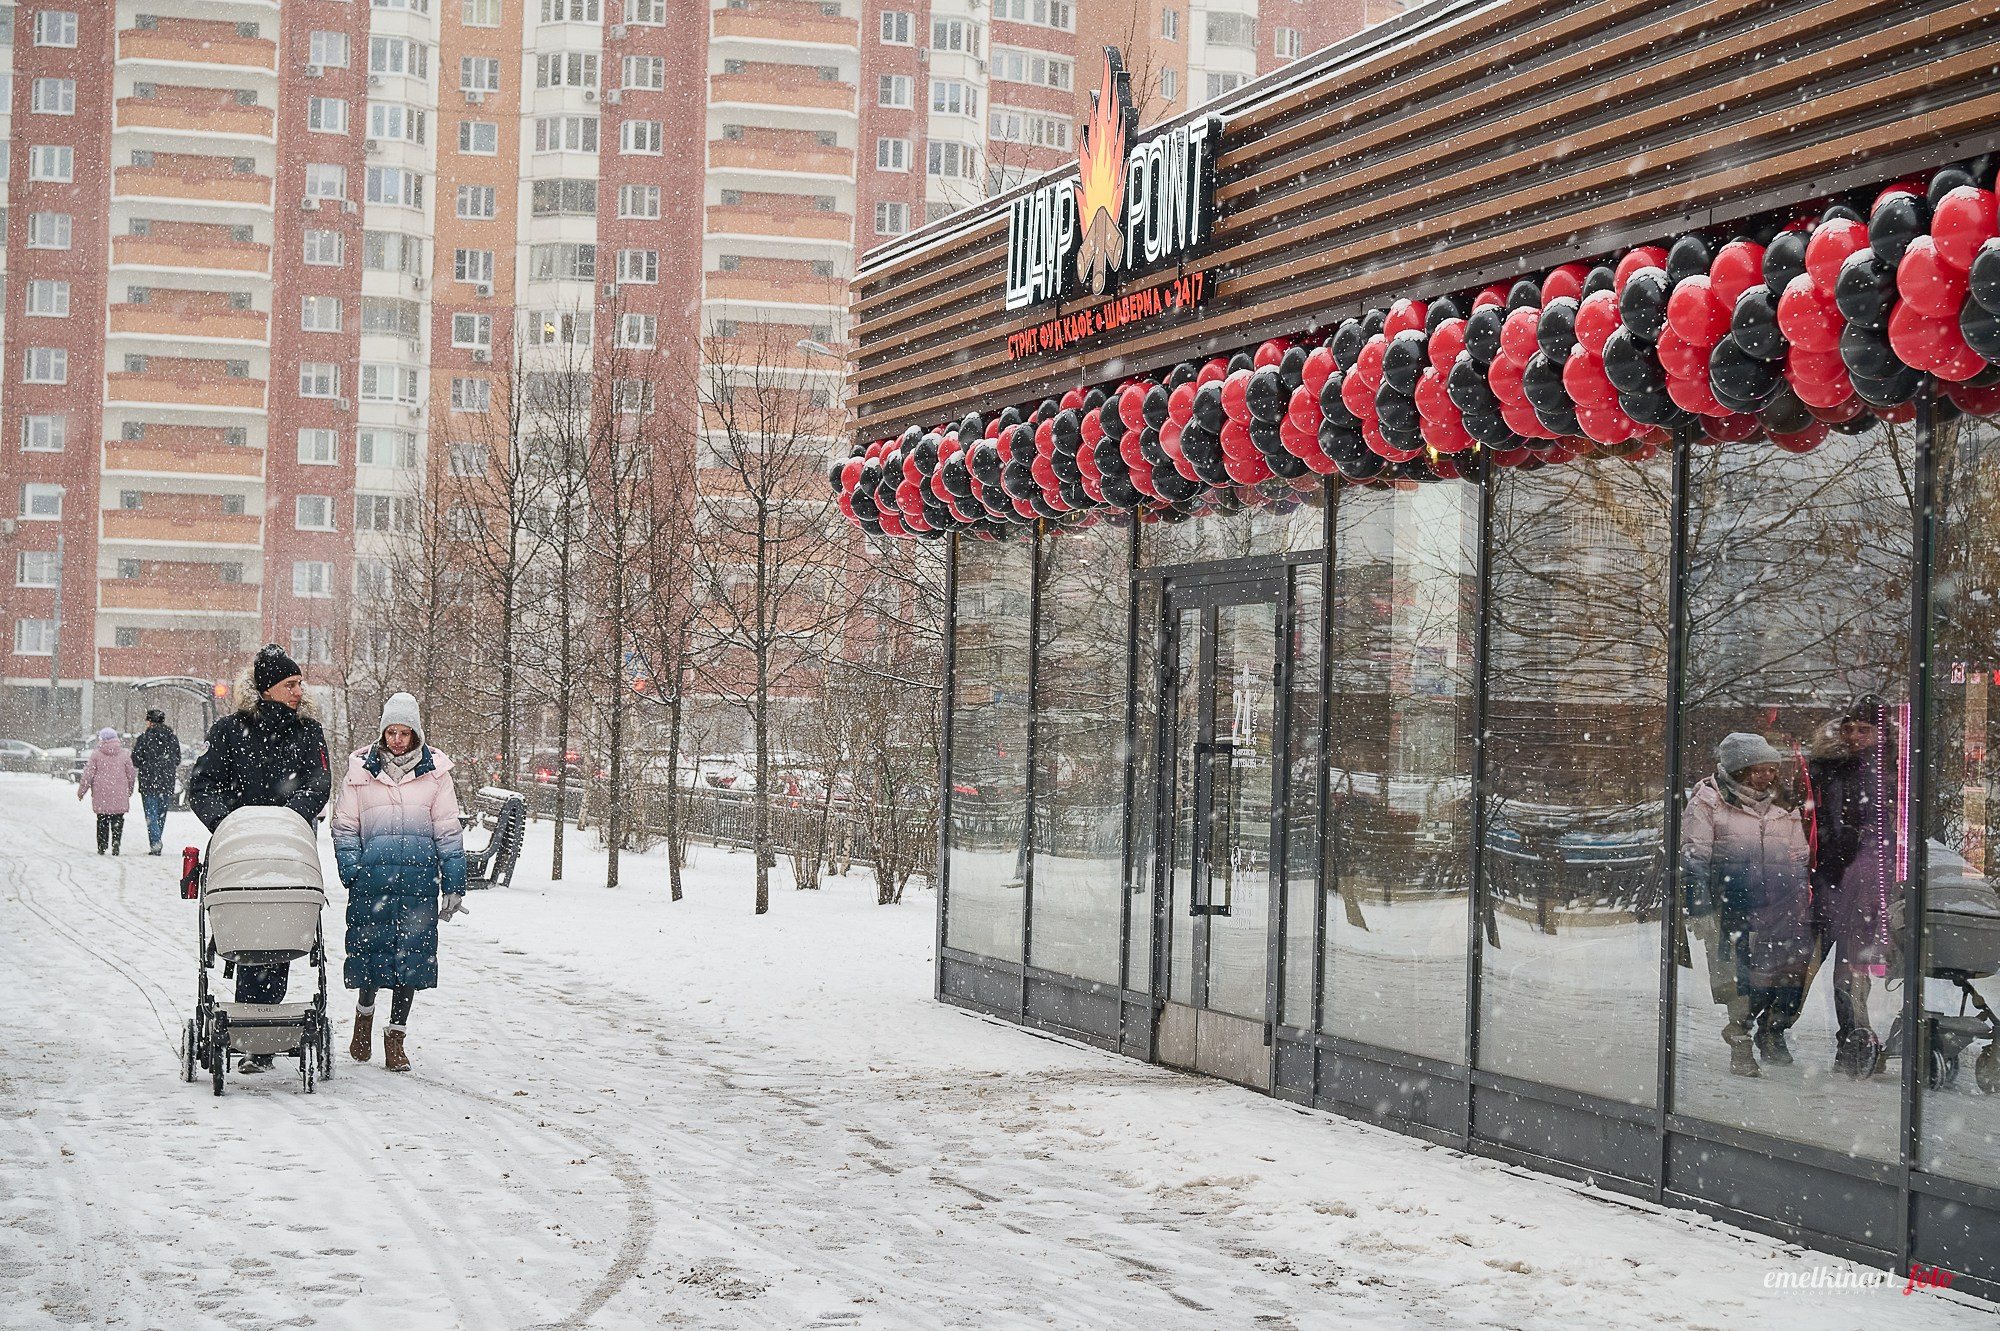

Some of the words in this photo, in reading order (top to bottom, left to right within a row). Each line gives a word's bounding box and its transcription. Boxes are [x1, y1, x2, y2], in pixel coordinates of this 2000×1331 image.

[1006, 179, 1074, 311] ШАУР
[1127, 116, 1209, 270] POINT
[1007, 327, 1038, 359] СТРИТ
[1039, 320, 1064, 351] ФУД
[1063, 311, 1094, 343] КАФЕ
[1103, 287, 1163, 330] ШАВЕРМА
[1232, 689, 1252, 746] 24
